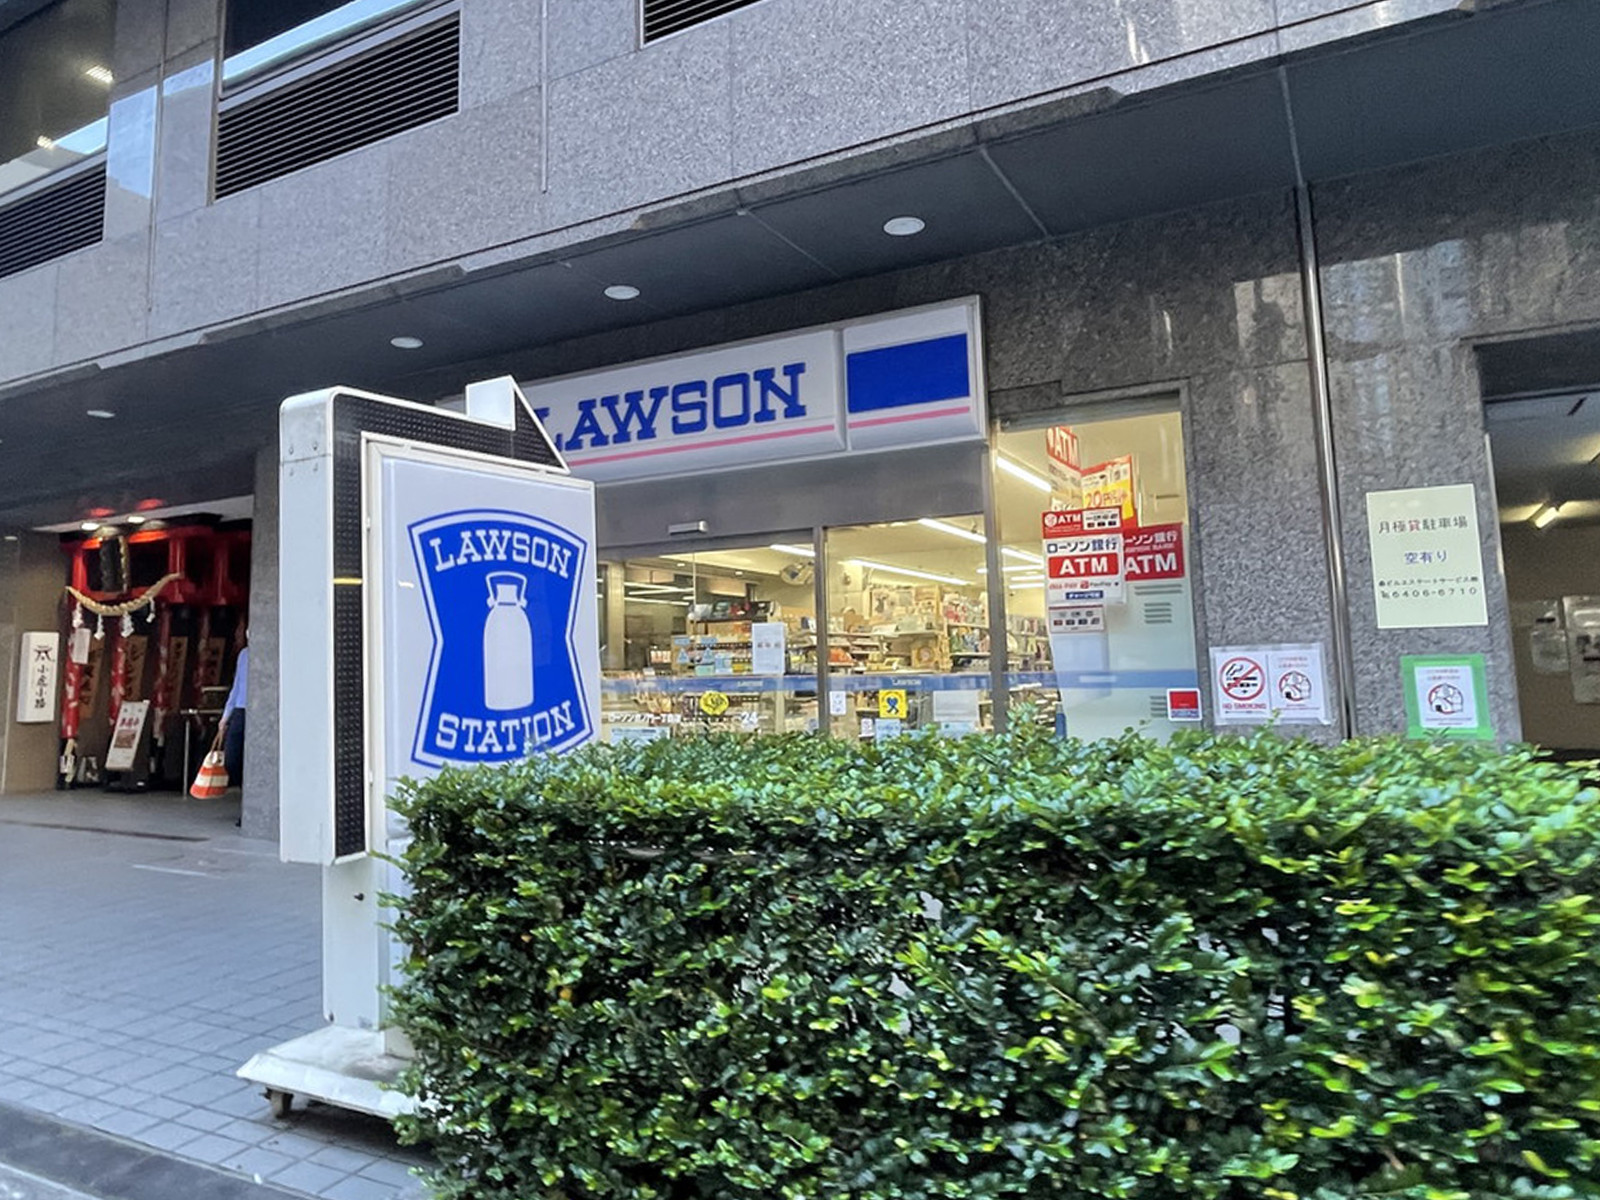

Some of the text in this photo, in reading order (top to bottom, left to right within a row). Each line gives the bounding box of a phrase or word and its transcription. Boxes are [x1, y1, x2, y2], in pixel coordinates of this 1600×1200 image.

[1058, 513, 1082, 524] ATM
[1379, 516, 1468, 534] 月極貸駐車場
[1047, 538, 1117, 553] ローソン銀行
[1125, 530, 1177, 545] ーソン銀行
[429, 529, 571, 579] LAWSON
[1404, 550, 1447, 565] 空有り
[1059, 556, 1109, 576] ATM
[1125, 552, 1177, 575] ATM
[435, 700, 575, 753] STATION
